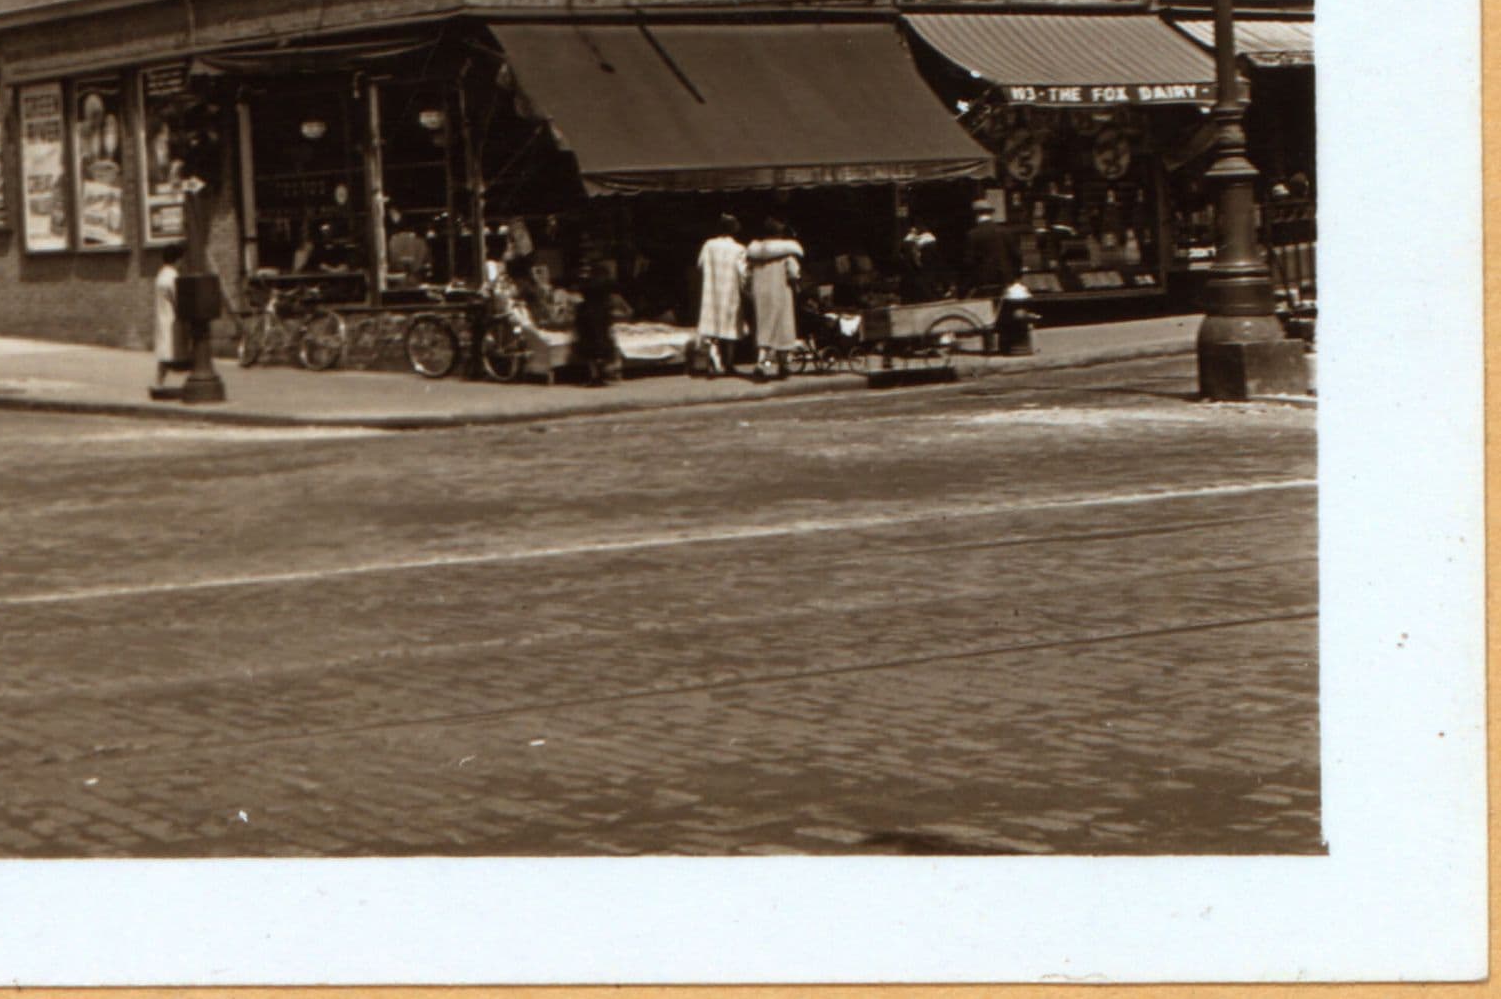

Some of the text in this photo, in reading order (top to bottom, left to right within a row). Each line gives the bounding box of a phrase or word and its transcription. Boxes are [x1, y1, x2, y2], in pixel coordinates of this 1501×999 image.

[1049, 86, 1082, 101] THE
[1092, 87, 1129, 101] FOX
[1138, 85, 1197, 100] DAIRY
